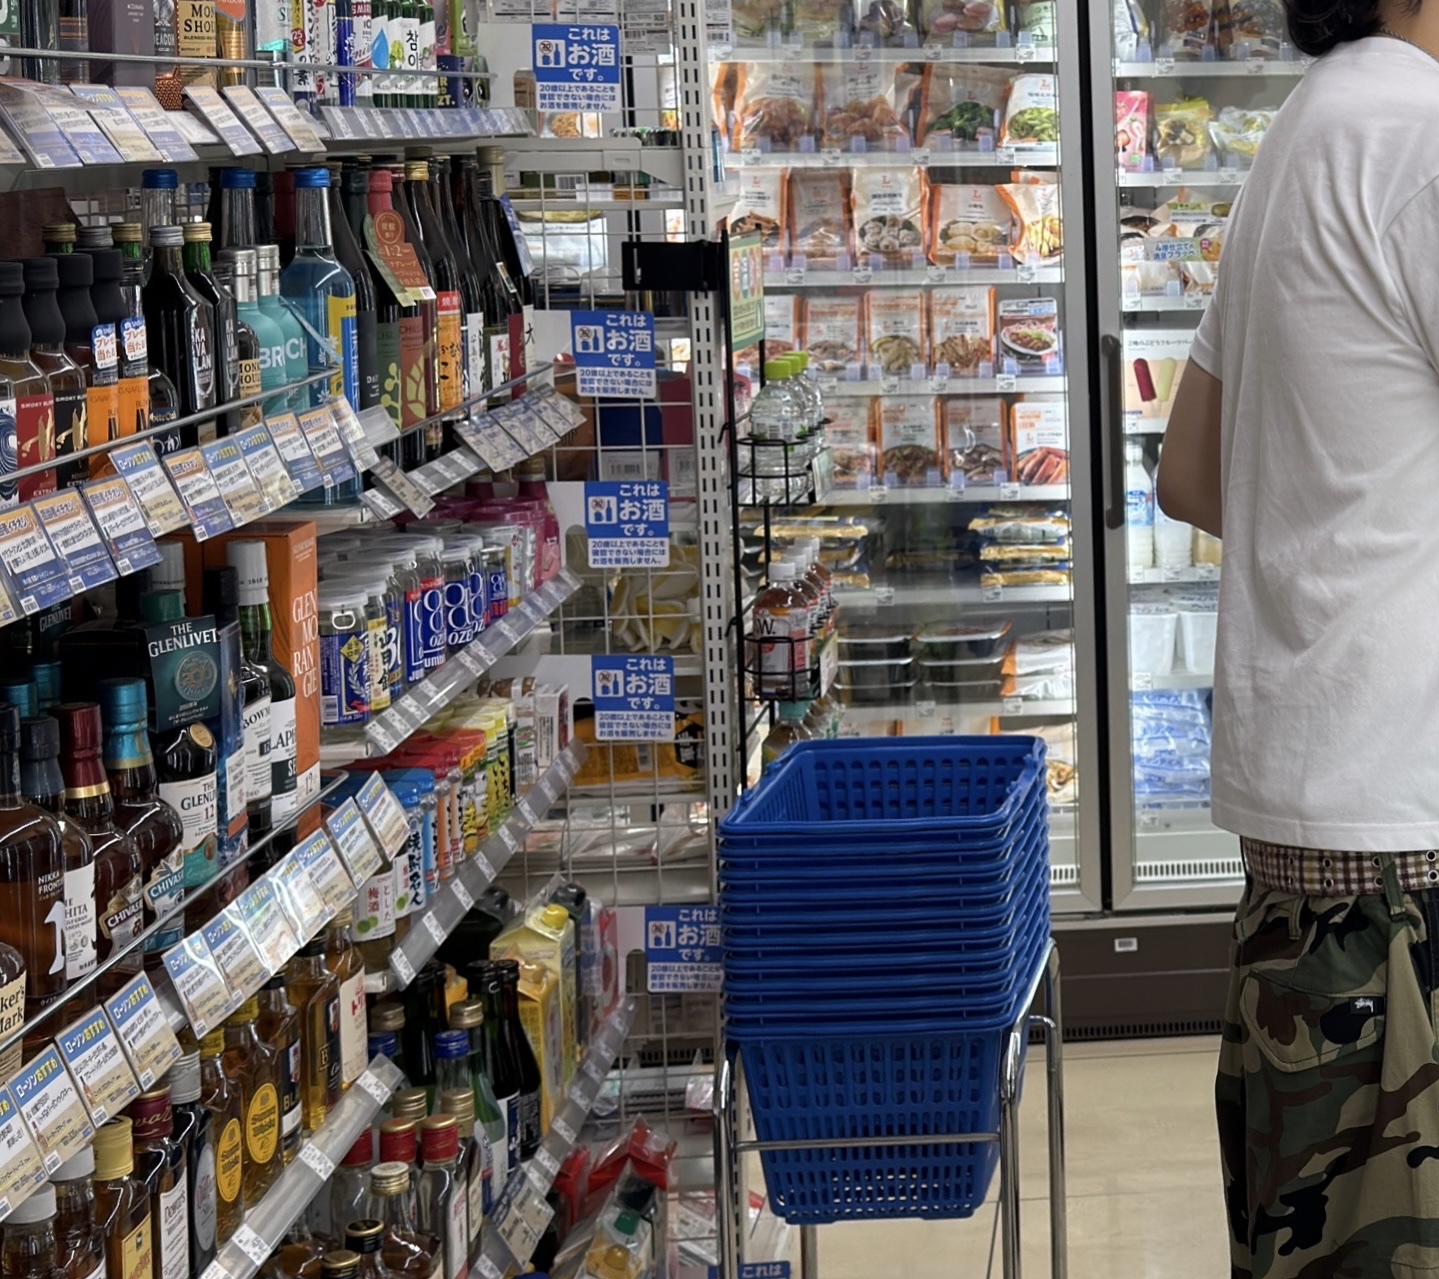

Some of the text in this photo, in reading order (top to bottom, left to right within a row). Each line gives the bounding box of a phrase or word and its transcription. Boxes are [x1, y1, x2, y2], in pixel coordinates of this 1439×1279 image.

[568, 28, 610, 41] これは
[568, 43, 615, 66] お酒
[569, 68, 604, 81] です。
[606, 314, 647, 327] これは
[606, 329, 652, 352] お酒
[607, 353, 641, 367] です。
[620, 484, 660, 497] これは
[620, 499, 665, 521] お酒
[620, 523, 654, 536] です。
[292, 588, 318, 624] GLEN
[170, 622, 193, 636] THE
[148, 628, 218, 658] GLENLIVET
[293, 644, 314, 678] RAN
[626, 658, 667, 671] これは
[626, 673, 672, 696] お酒
[627, 697, 660, 710] です。
[367, 887, 380, 913] 梅酒
[106, 901, 143, 928] CHIVAS
[679, 908, 717, 922] これは
[678, 924, 721, 946] お酒
[678, 948, 711, 961] です。
[742, 1264, 781, 1278] これは
